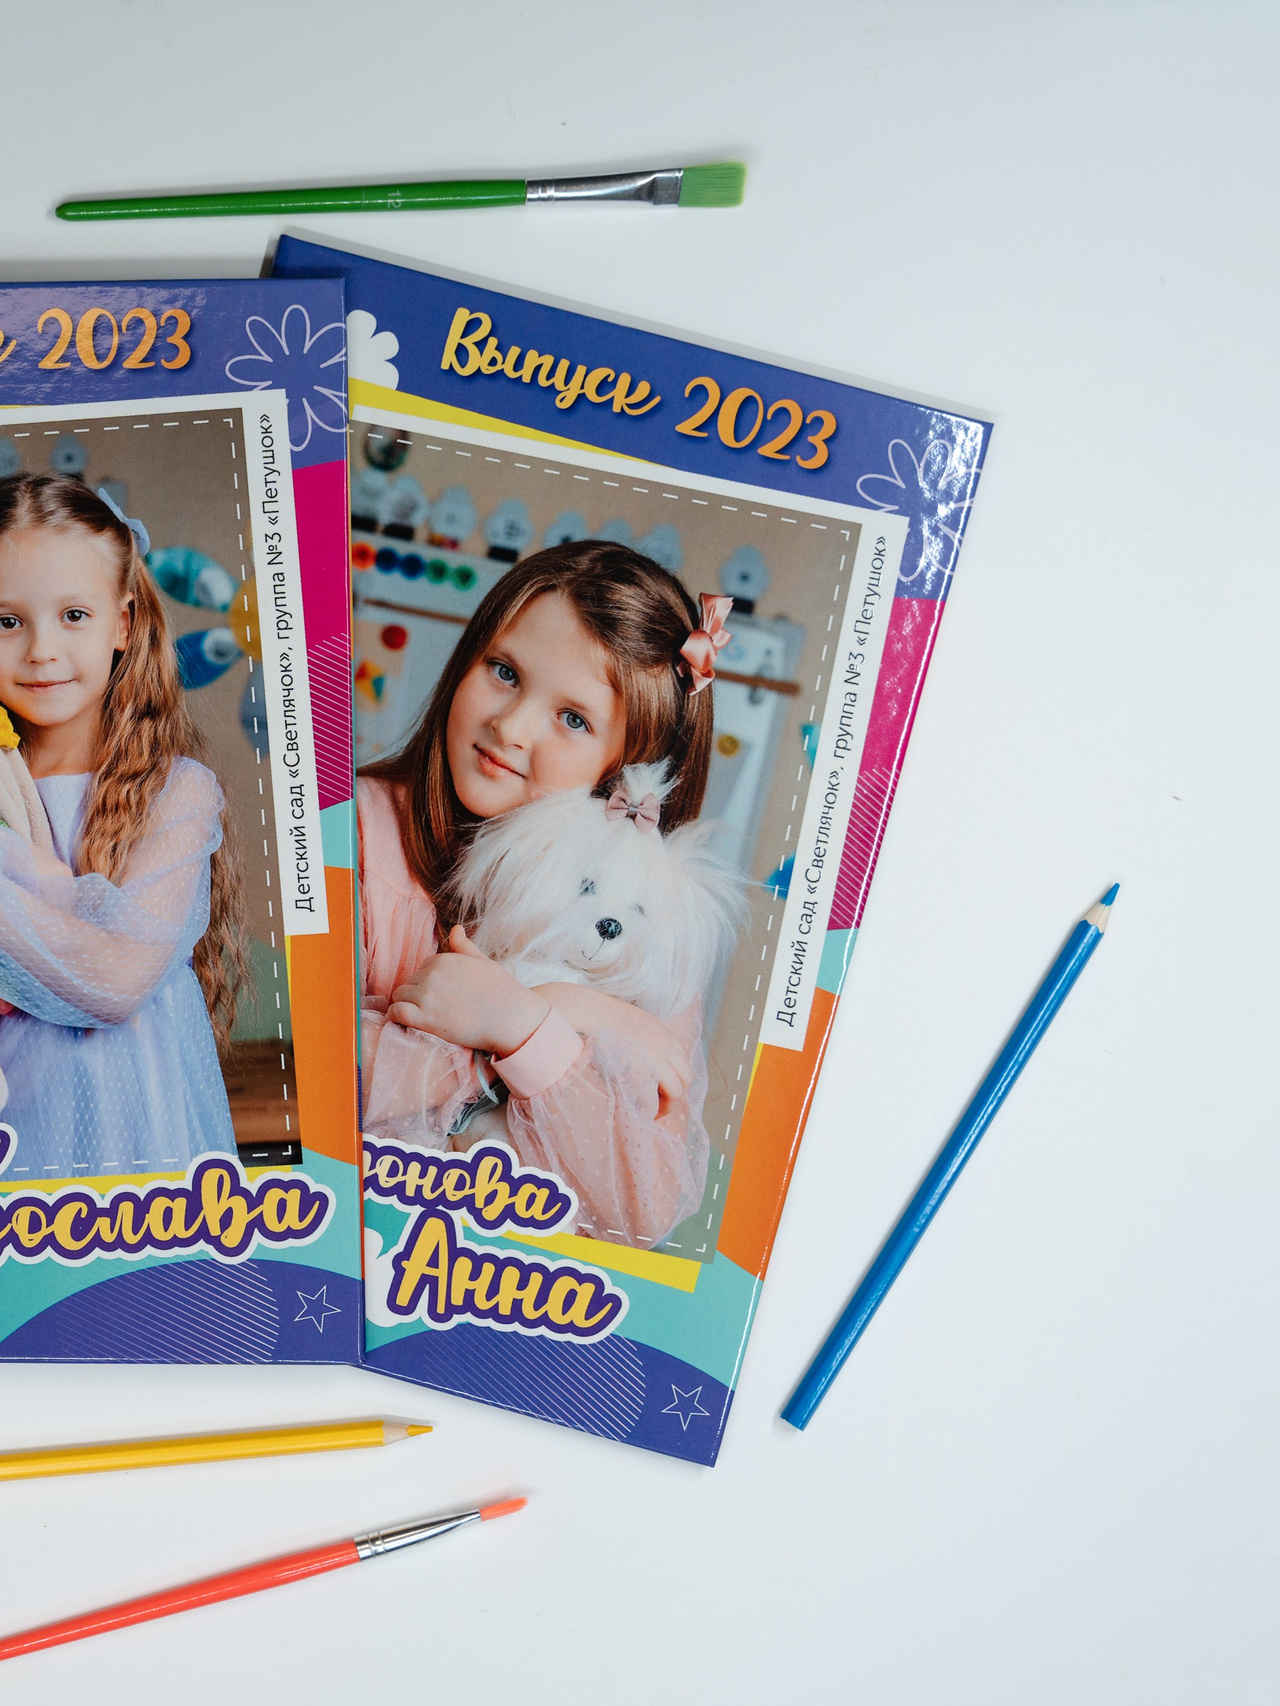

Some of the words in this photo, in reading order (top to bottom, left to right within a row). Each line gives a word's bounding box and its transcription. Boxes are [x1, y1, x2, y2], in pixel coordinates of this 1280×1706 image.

[387, 189, 403, 209] 12
[36, 307, 192, 371] 2023
[440, 306, 662, 417] Выпуск
[674, 375, 838, 470] 2023
[259, 413, 281, 526] «Петушок»
[264, 532, 284, 566] №3
[272, 571, 294, 641] группа
[853, 535, 887, 647] «Петушок»
[843, 651, 865, 687] №3
[279, 646, 301, 779] «Светлячок»,
[833, 691, 858, 760] группа
[290, 783, 305, 819] сад
[804, 766, 845, 896] «Светлячок»,
[288, 824, 315, 912] Детский
[797, 900, 818, 936] сад
[775, 940, 808, 1028] Детский
[394, 1215, 615, 1329] Анна
